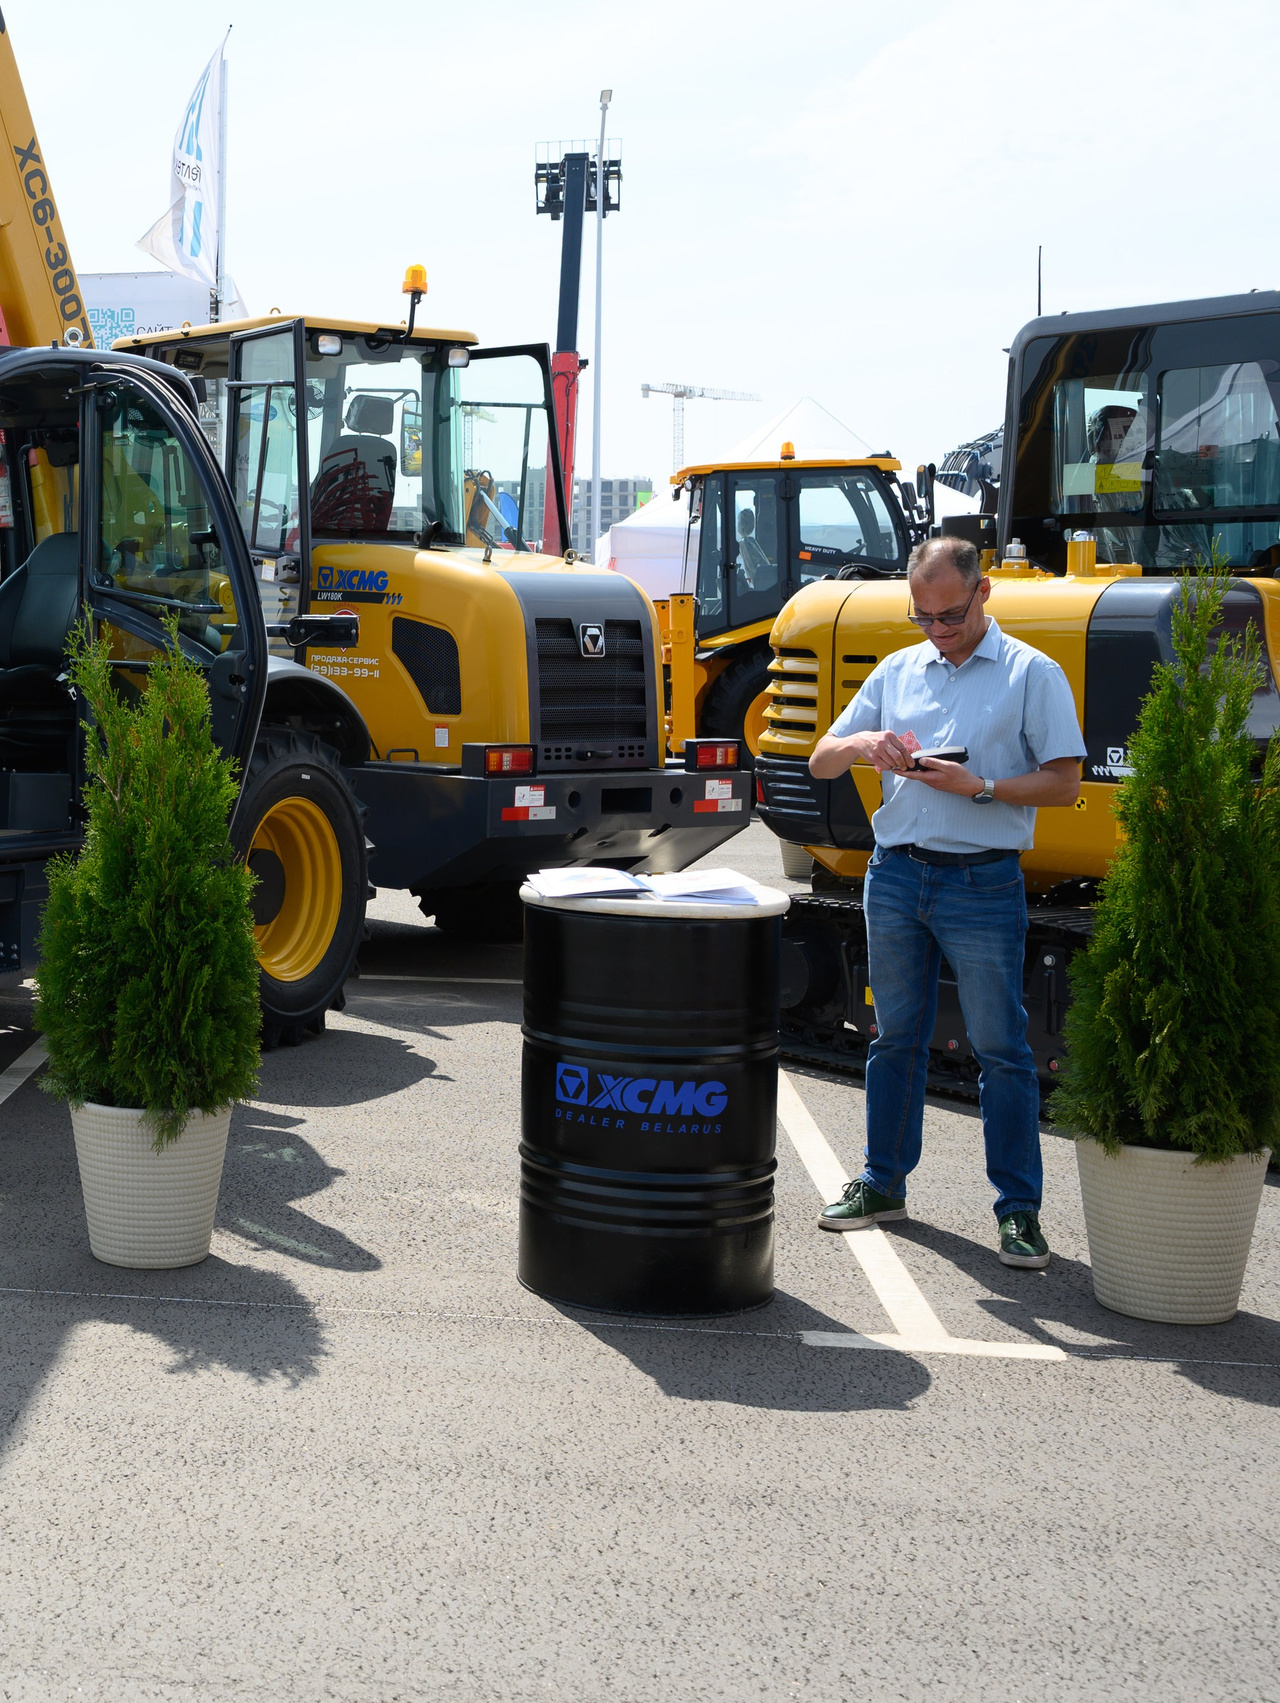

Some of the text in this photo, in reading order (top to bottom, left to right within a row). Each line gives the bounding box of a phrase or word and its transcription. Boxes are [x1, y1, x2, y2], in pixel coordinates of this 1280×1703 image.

[13, 136, 94, 349] XC6-3007
[333, 569, 389, 591] XCMG
[317, 592, 342, 600] LW180K
[588, 1074, 728, 1117] XCMG
[555, 1108, 723, 1134] DEALER BELARUS
